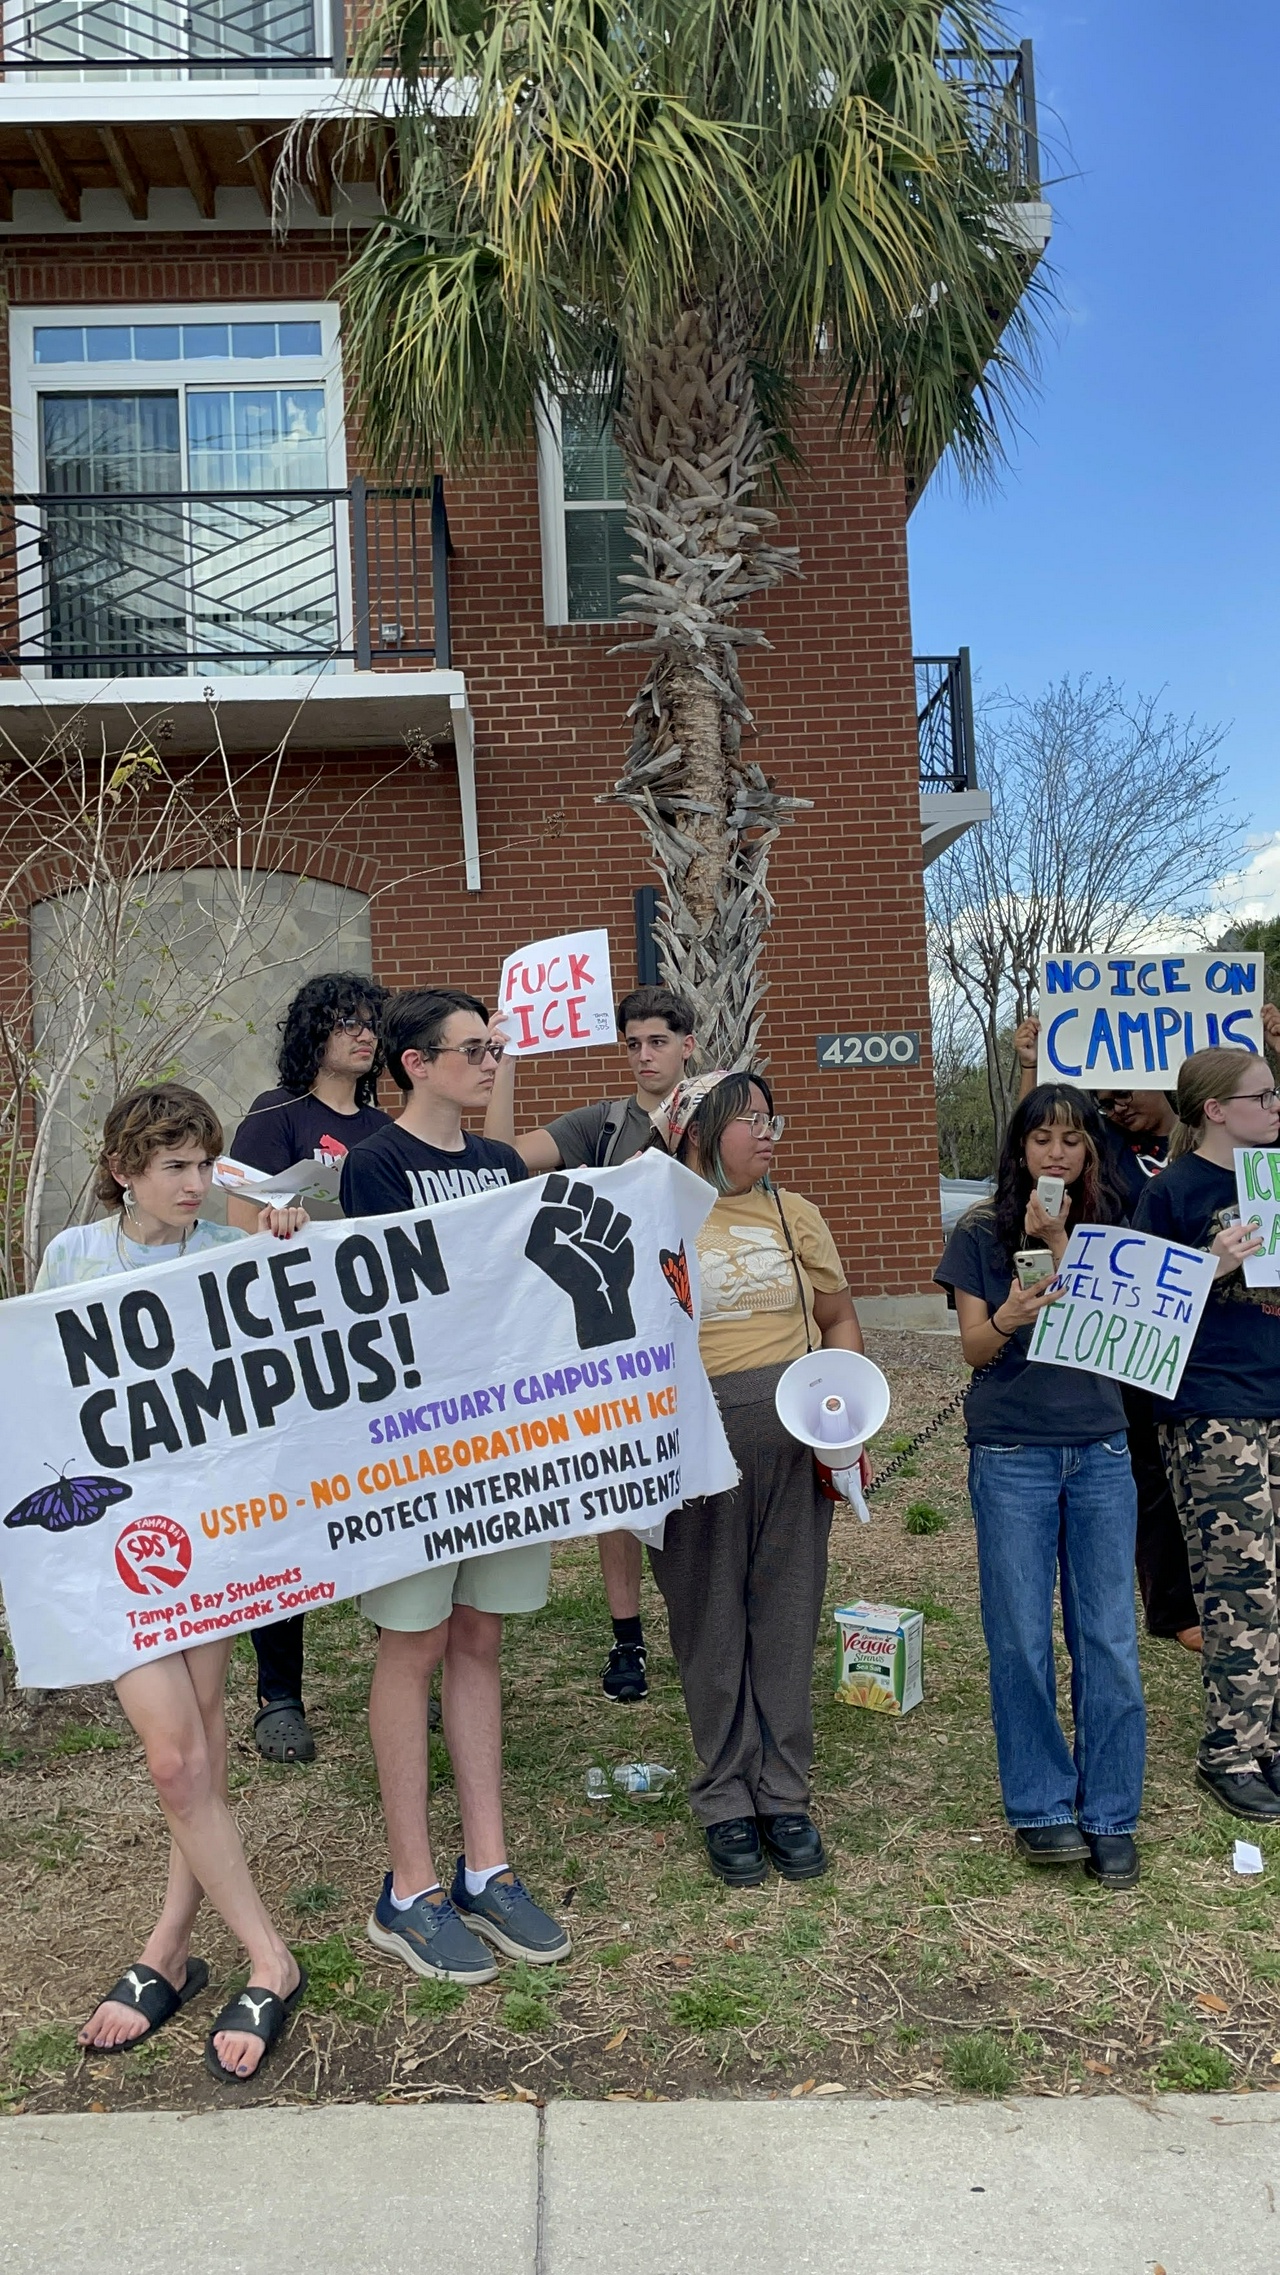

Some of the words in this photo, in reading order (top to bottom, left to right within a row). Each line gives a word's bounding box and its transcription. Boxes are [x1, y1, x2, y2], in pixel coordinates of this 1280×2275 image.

[506, 954, 595, 1002] FUCK
[1045, 960, 1101, 994] NO
[1108, 959, 1191, 996] ICE
[1205, 961, 1256, 995] ON
[512, 996, 591, 1049] ICE
[822, 1035, 914, 1064] 4200
[1047, 1007, 1258, 1076] CAMPUS
[1067, 1231, 1203, 1297] ICE
[55, 1289, 176, 1388] NO
[198, 1247, 324, 1351] ICE
[334, 1219, 450, 1315] ON
[1049, 1274, 1141, 1308] MELTS
[1152, 1293, 1193, 1324] IN
[1034, 1302, 1181, 1391] FLORIDA
[79, 1312, 422, 1469] CAMPUS!
[368, 1384, 506, 1444] SANCTUARY
[513, 1359, 613, 1405] CAMPUS
[616, 1342, 676, 1380] NOW!
[200, 1493, 288, 1539] USFPD
[310, 1474, 351, 1509] NO
[357, 1414, 570, 1494] COLLABORATION
[573, 1395, 642, 1437] WITH
[647, 1385, 678, 1419] ICE!
[327, 1491, 439, 1550] PROTECT
[446, 1439, 651, 1515] INTERNATIONAL
[127, 1534, 165, 1562] SDS
[134, 1518, 167, 1530] TAMPA
[166, 1522, 187, 1540] BAY
[424, 1498, 570, 1562] IMMIGRANT
[126, 1602, 187, 1629] Tampa
[190, 1591, 225, 1613] Bay
[226, 1567, 301, 1604] Students
[133, 1631, 160, 1651] for
[164, 1627, 178, 1642] a
[180, 1599, 274, 1638] Democratic
[278, 1581, 335, 1610] Society
[842, 1630, 897, 1655] Veggie
